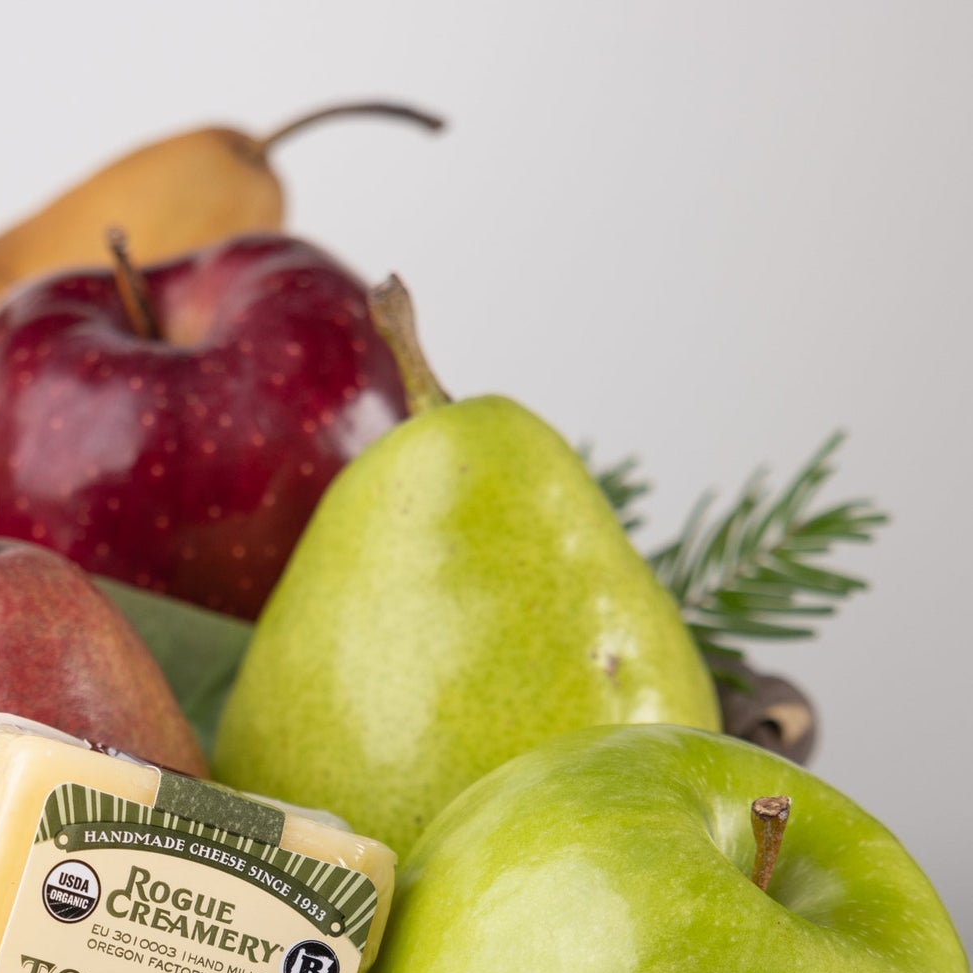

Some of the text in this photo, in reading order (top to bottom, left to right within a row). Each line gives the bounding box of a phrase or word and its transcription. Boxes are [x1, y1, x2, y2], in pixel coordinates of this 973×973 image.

[58, 872, 89, 893] USDA
[84, 831, 327, 922] HANDMADE CHEESE SINCE 1933
[49, 889, 89, 910] ORGANIC
[125, 865, 236, 925] ROGUE
[91, 923, 110, 937] EU
[105, 888, 280, 964] CREAMERY
[87, 939, 143, 963] OREGON
